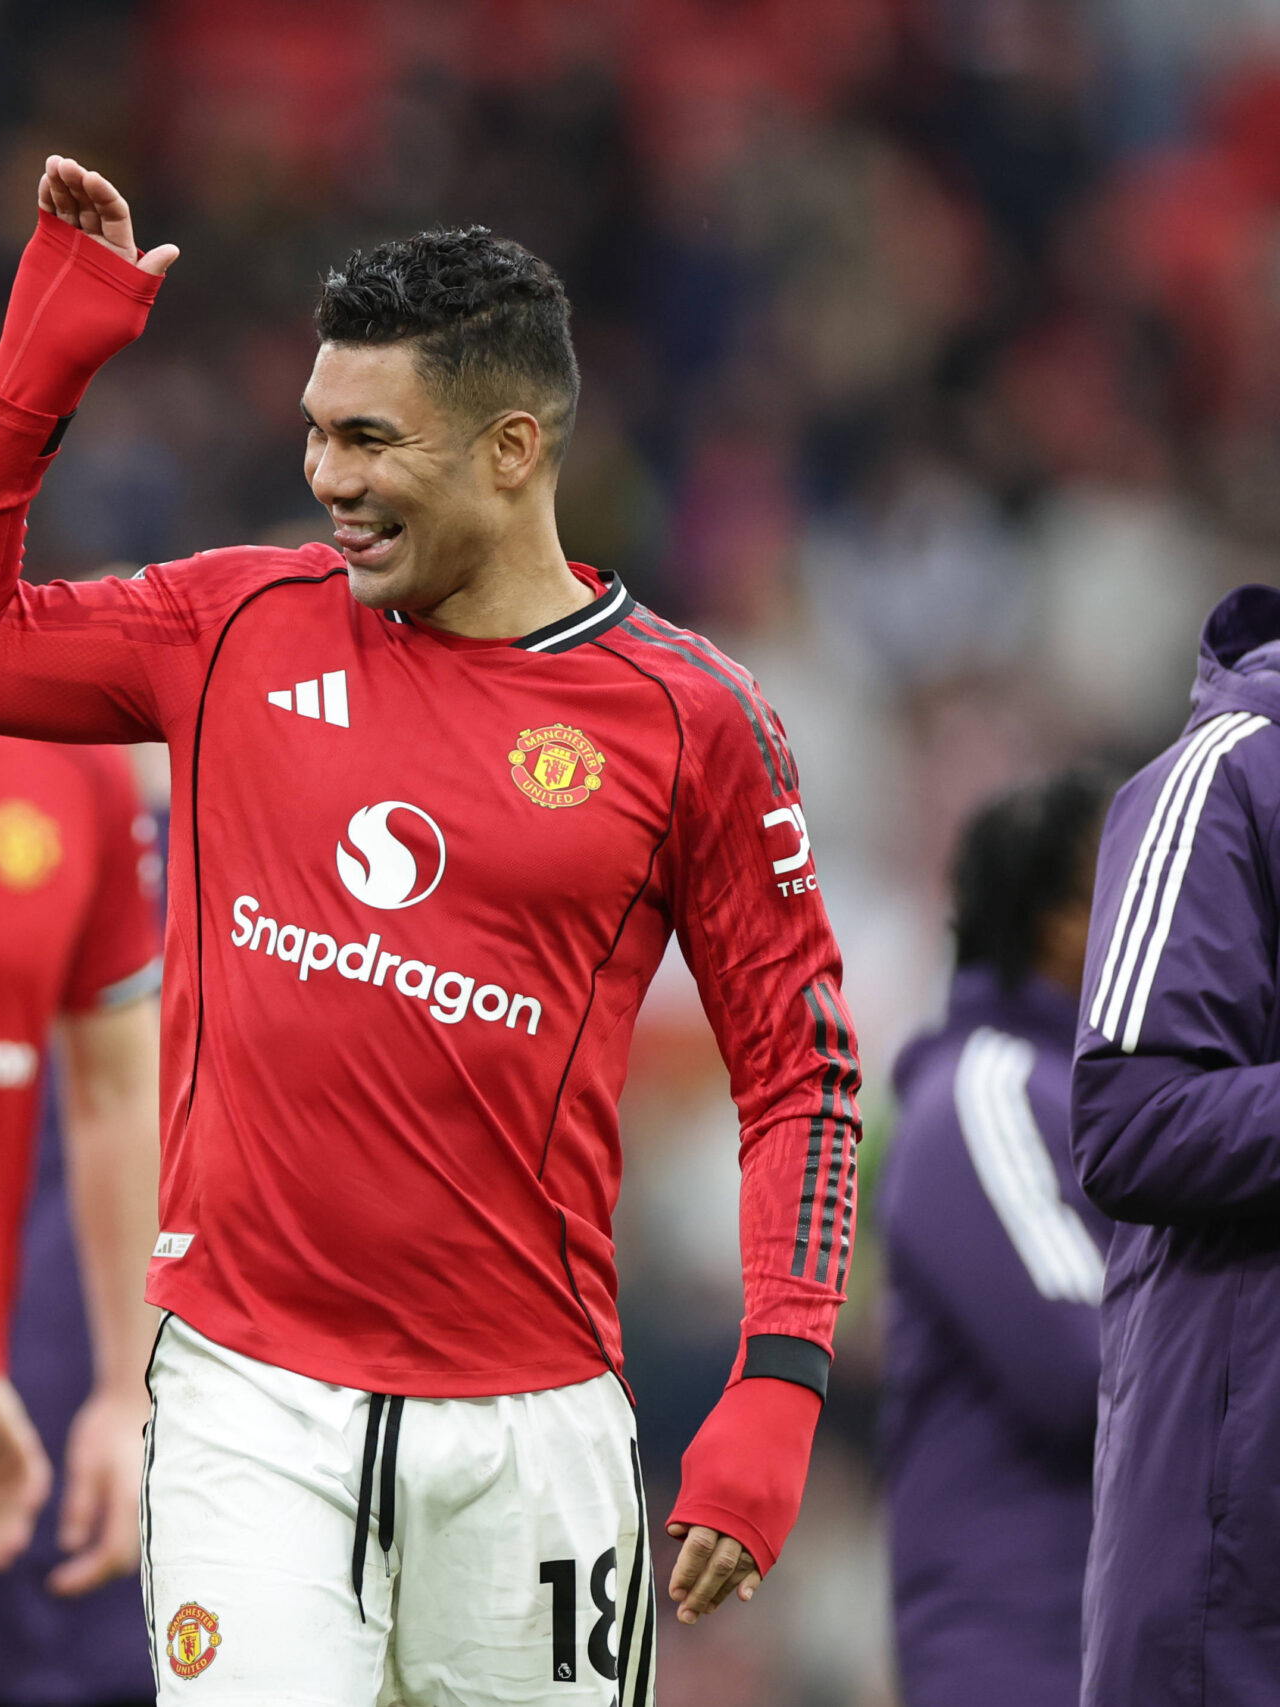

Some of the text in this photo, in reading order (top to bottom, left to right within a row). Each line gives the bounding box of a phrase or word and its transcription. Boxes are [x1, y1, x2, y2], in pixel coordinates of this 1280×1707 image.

[524, 730, 596, 768] MANCHESTER
[522, 780, 574, 804] UNITED
[231, 895, 542, 1036] Snapdragon
[169, 1608, 214, 1637] MANCHESTER
[540, 1546, 619, 1683] 18
[176, 1658, 208, 1674] UNITED
